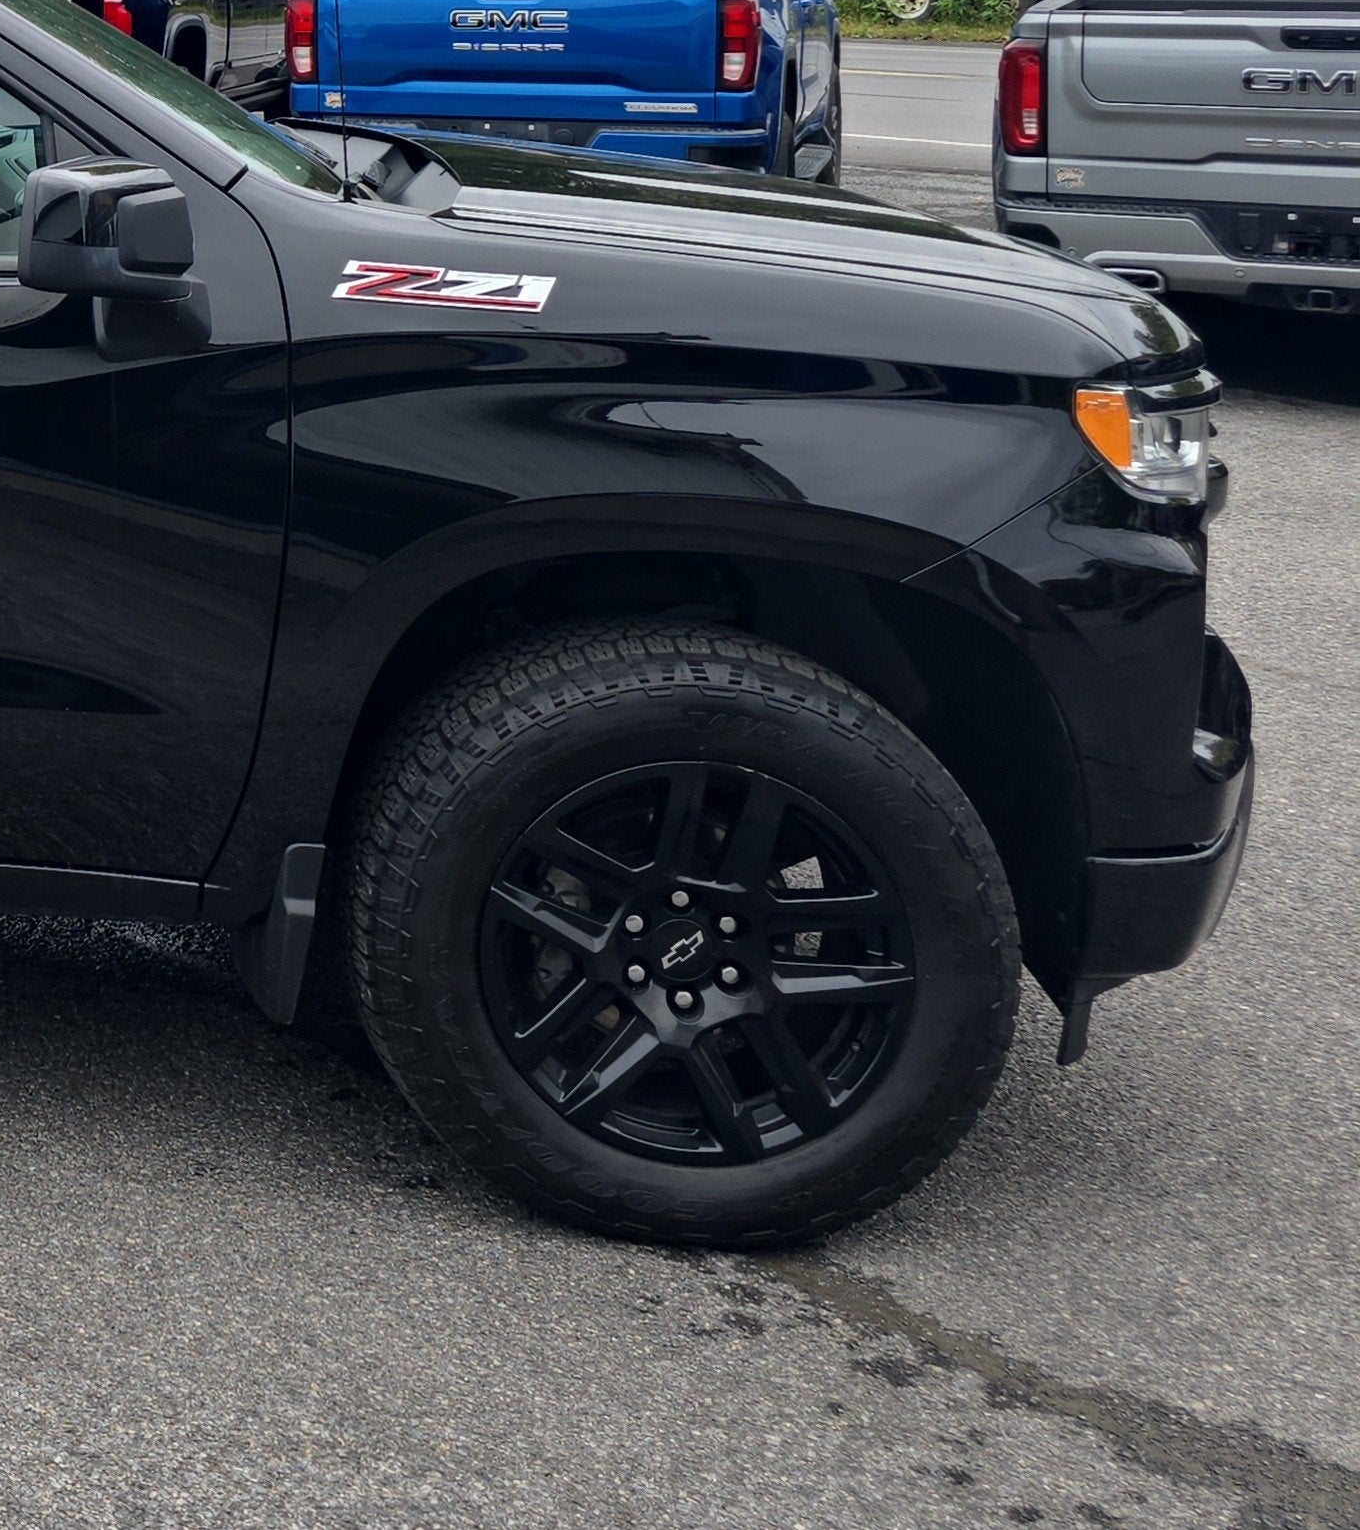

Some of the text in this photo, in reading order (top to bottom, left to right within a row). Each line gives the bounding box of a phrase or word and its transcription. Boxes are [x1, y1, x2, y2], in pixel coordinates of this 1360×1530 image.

[450, 10, 569, 33] GMC
[452, 42, 565, 52] SIERRA
[332, 260, 557, 313] Z71
